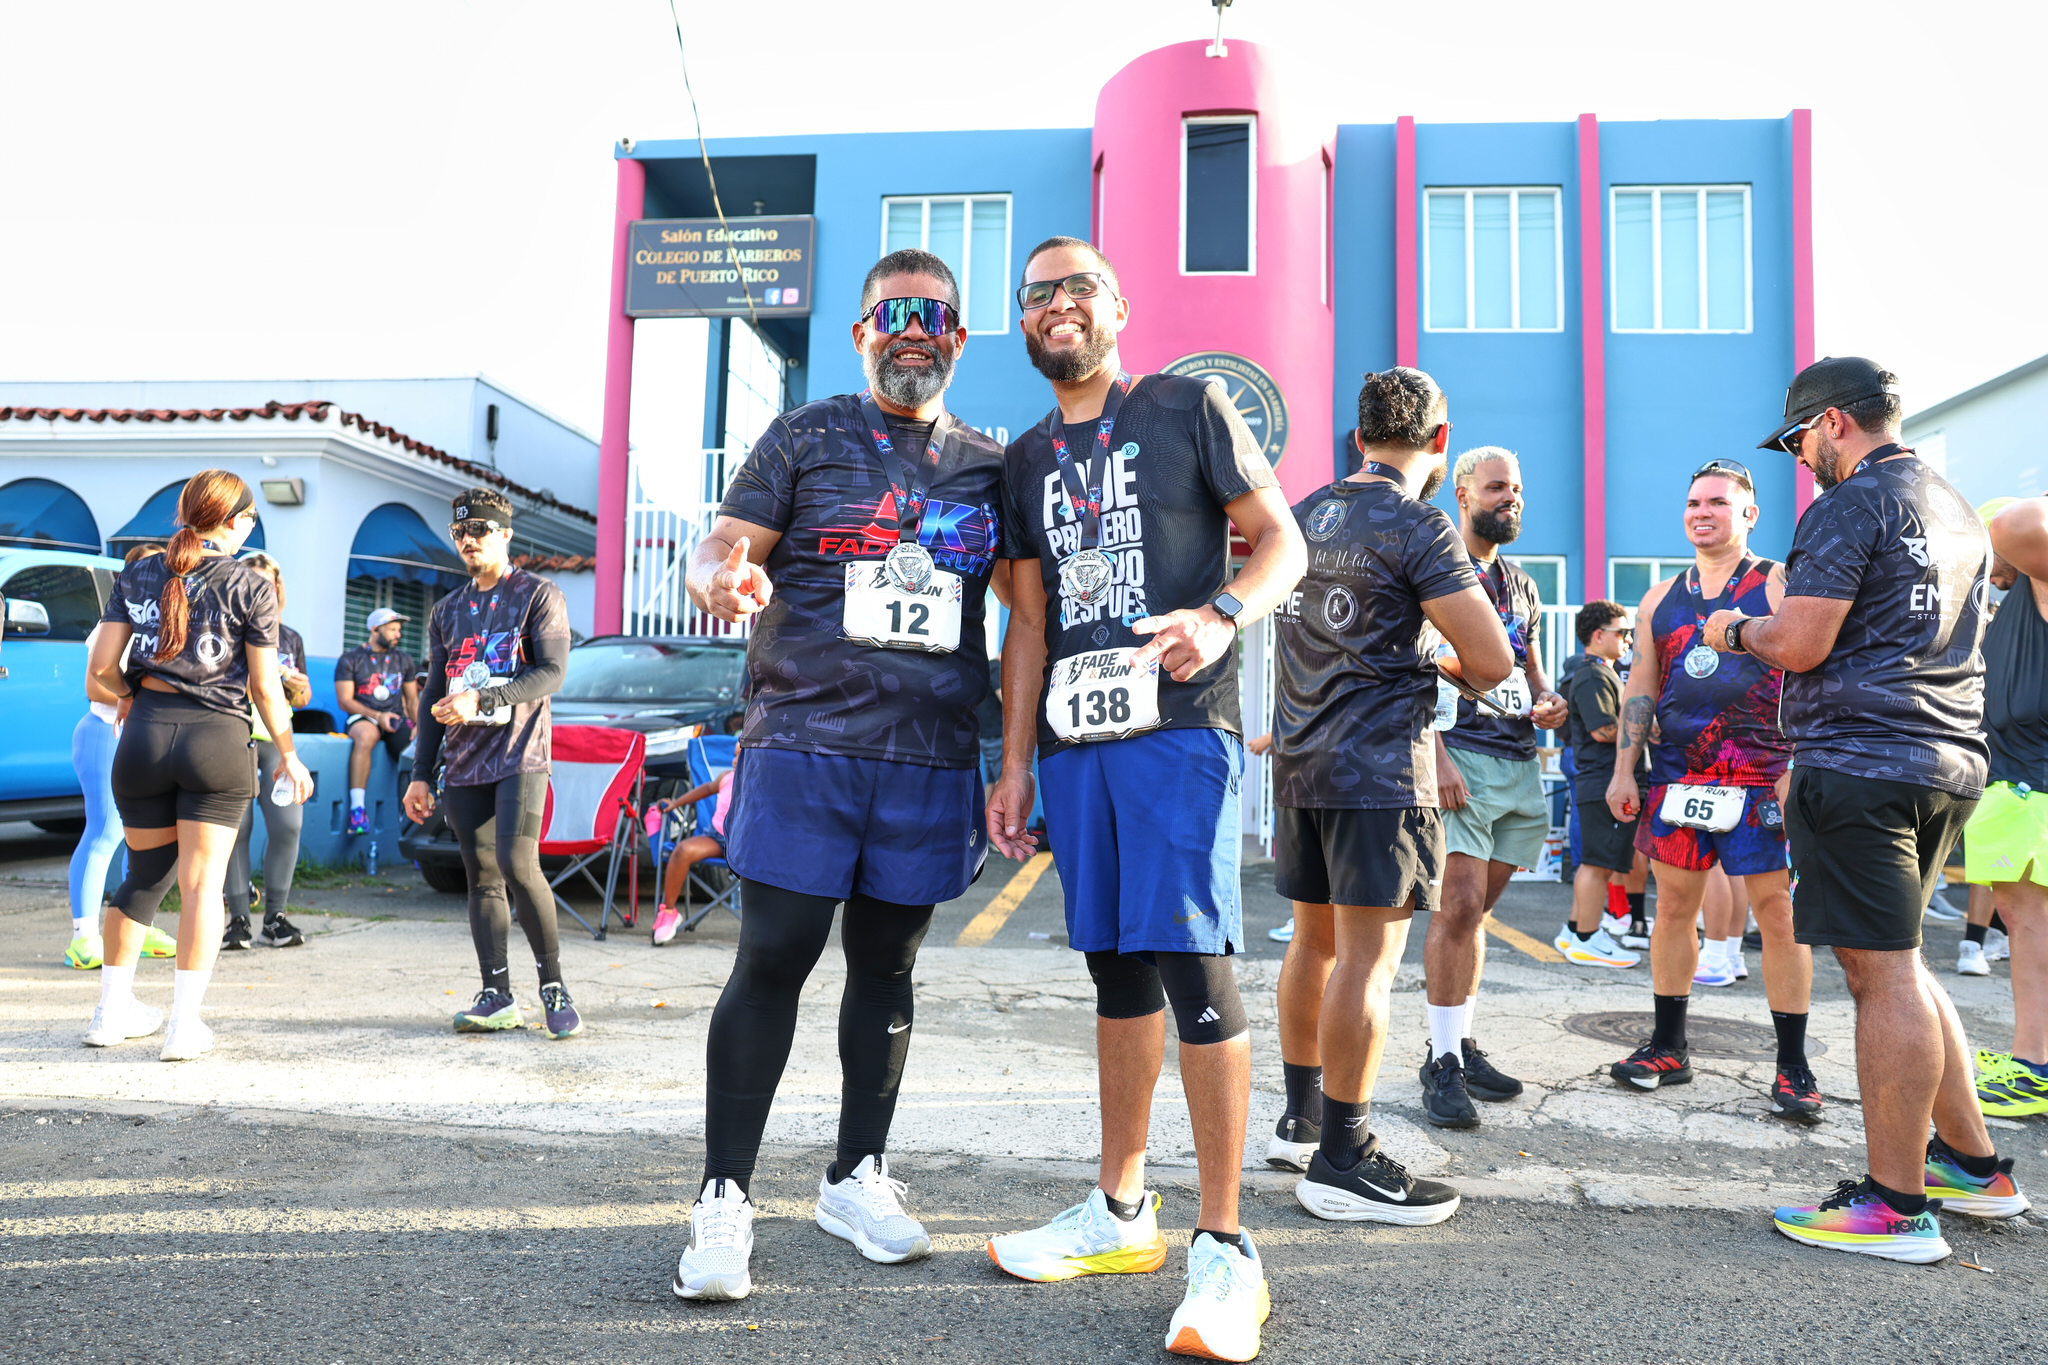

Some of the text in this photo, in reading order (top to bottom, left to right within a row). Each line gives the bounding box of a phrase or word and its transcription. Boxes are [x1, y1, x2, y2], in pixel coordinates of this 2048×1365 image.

[661, 228, 778, 243] Salón Educativo
[636, 248, 802, 265] COLEGIO DE BARBEROS
[656, 267, 779, 284] DE PUERTO RICO
[886, 600, 930, 636] 12
[1081, 652, 1119, 670] FADE
[1089, 664, 1131, 679] & RUN
[1068, 687, 1131, 728] 138
[1705, 787, 1729, 797] RUN
[1684, 798, 1715, 821] 65
[1886, 1217, 1933, 1235] HOKA
